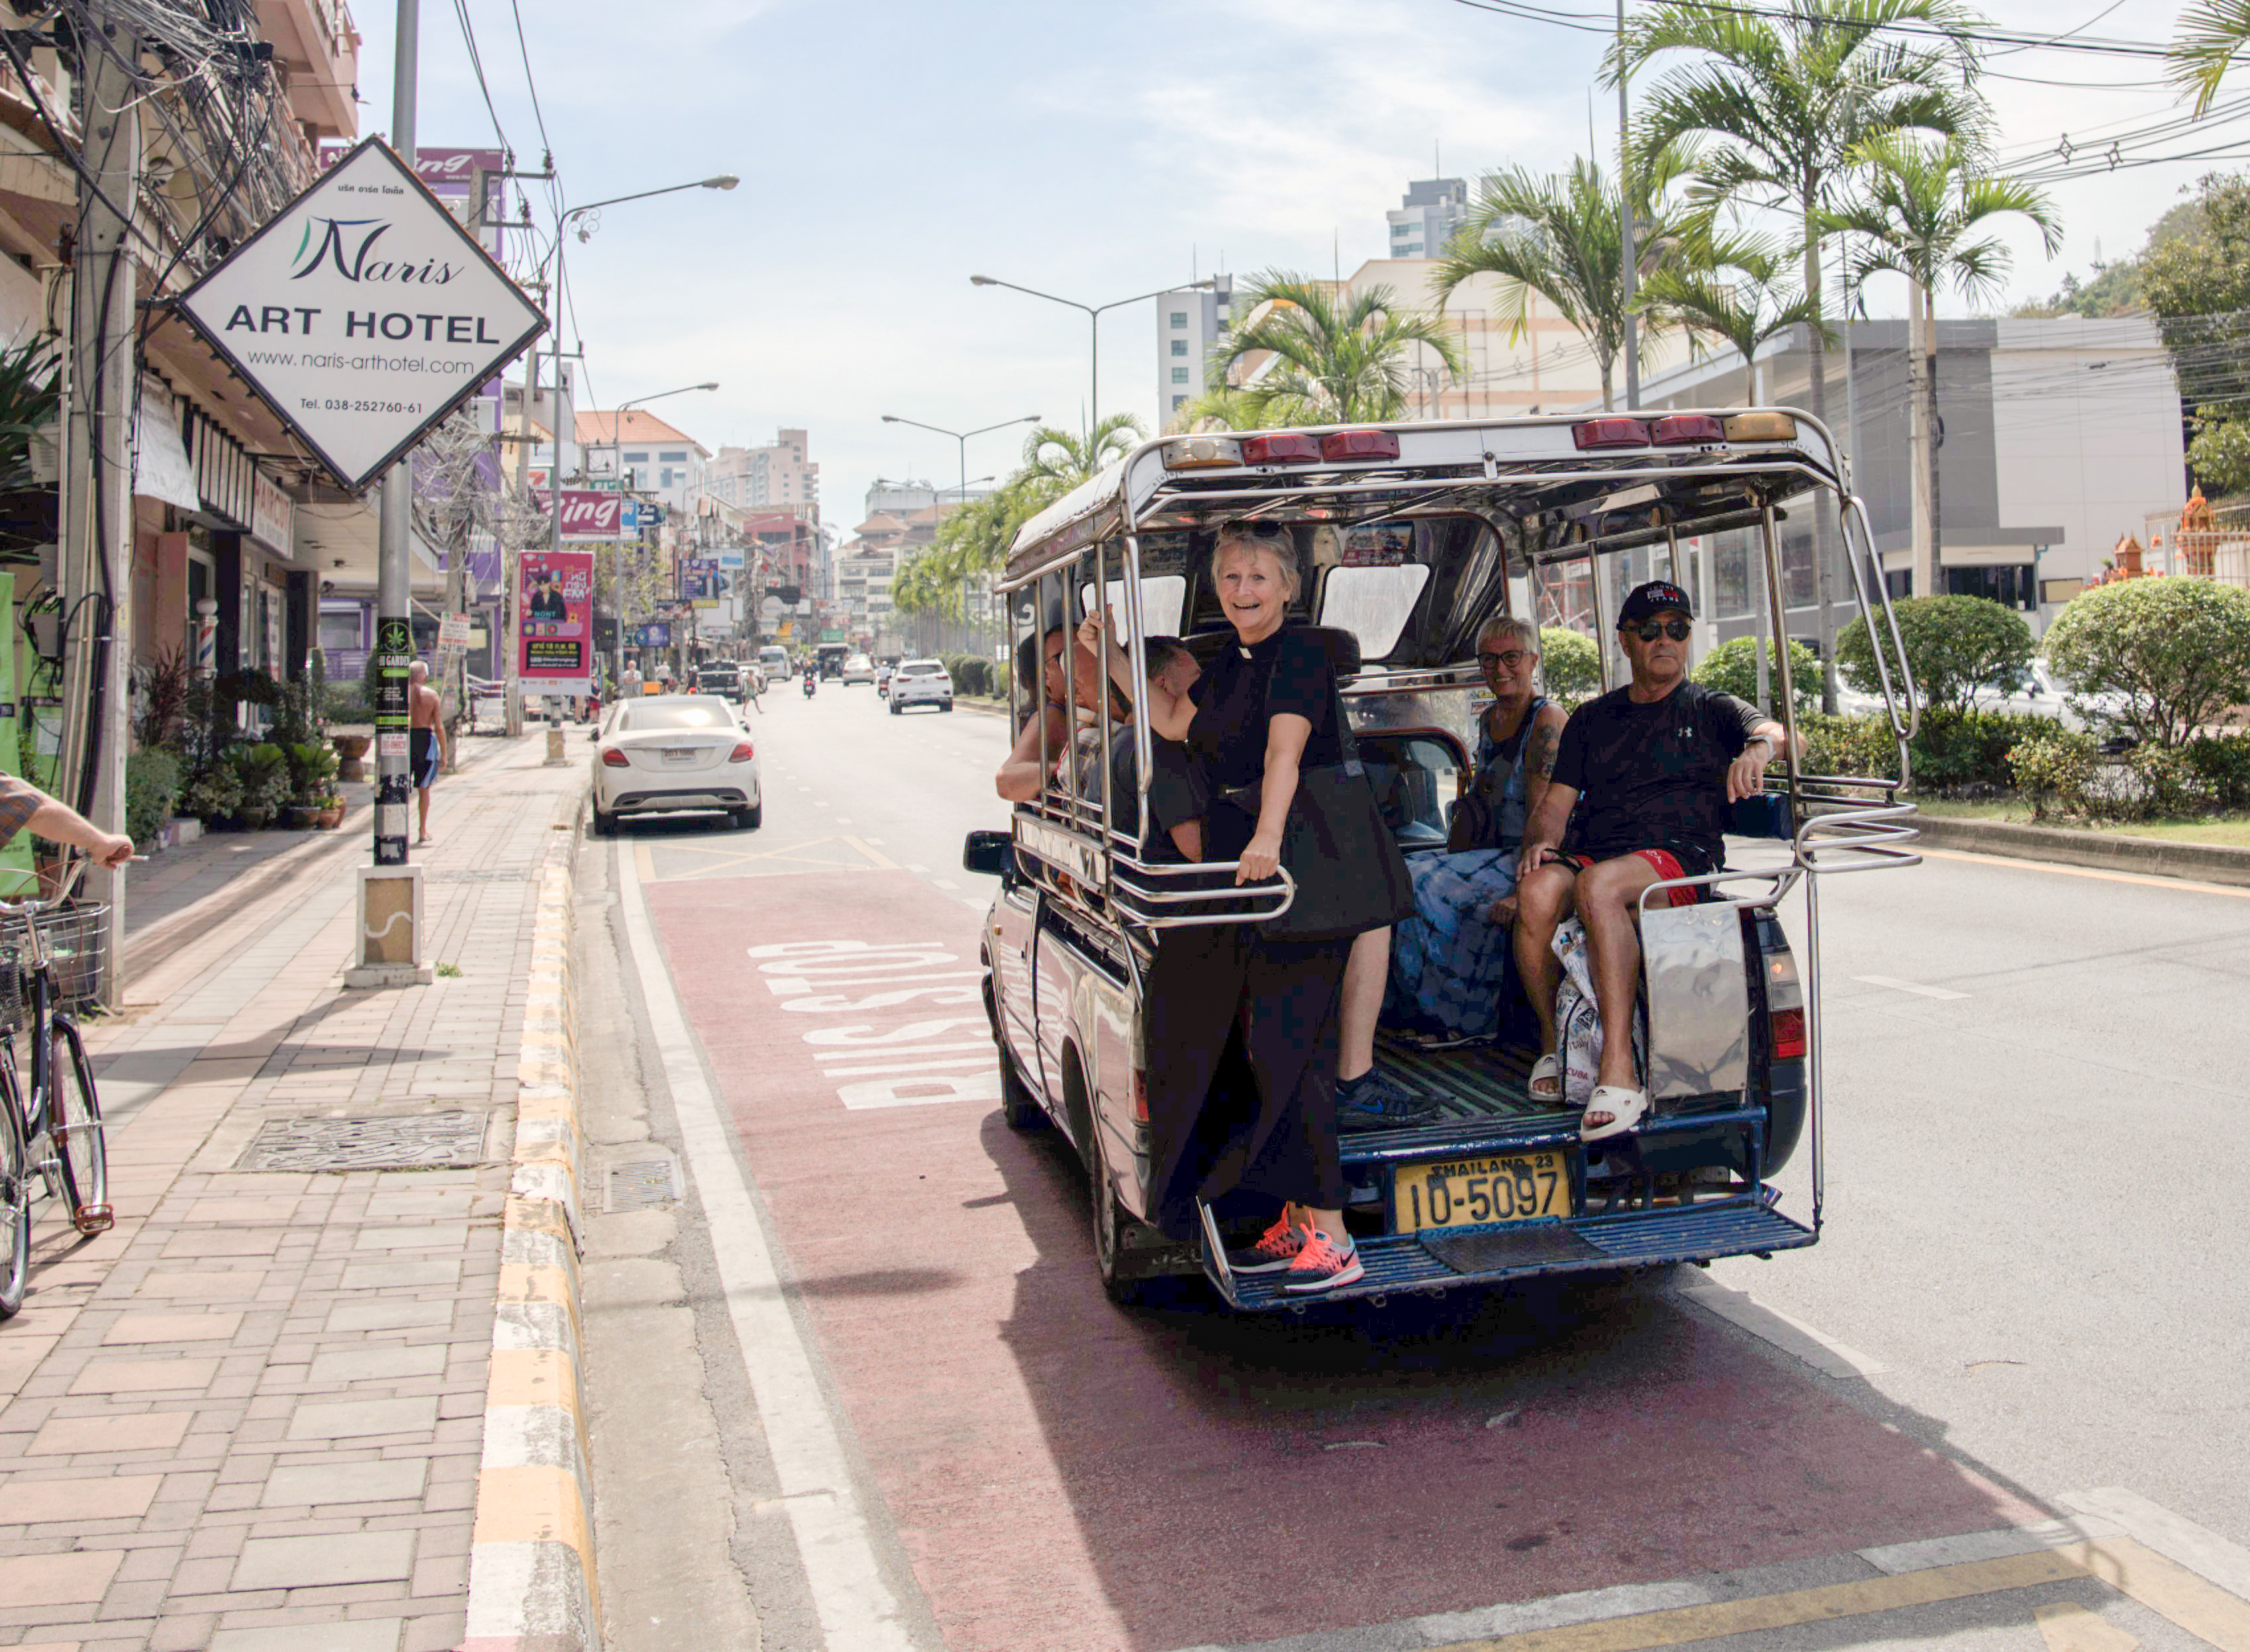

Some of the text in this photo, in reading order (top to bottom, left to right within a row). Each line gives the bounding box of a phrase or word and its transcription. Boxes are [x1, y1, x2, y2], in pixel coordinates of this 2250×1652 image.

[290, 215, 465, 285] Naris
[225, 305, 500, 344] ART HOTEL
[301, 398, 422, 414] Tel. 038-252760-61
[1431, 1155, 1554, 1177] THAILAND 23
[1410, 1171, 1557, 1228] 10-5097
